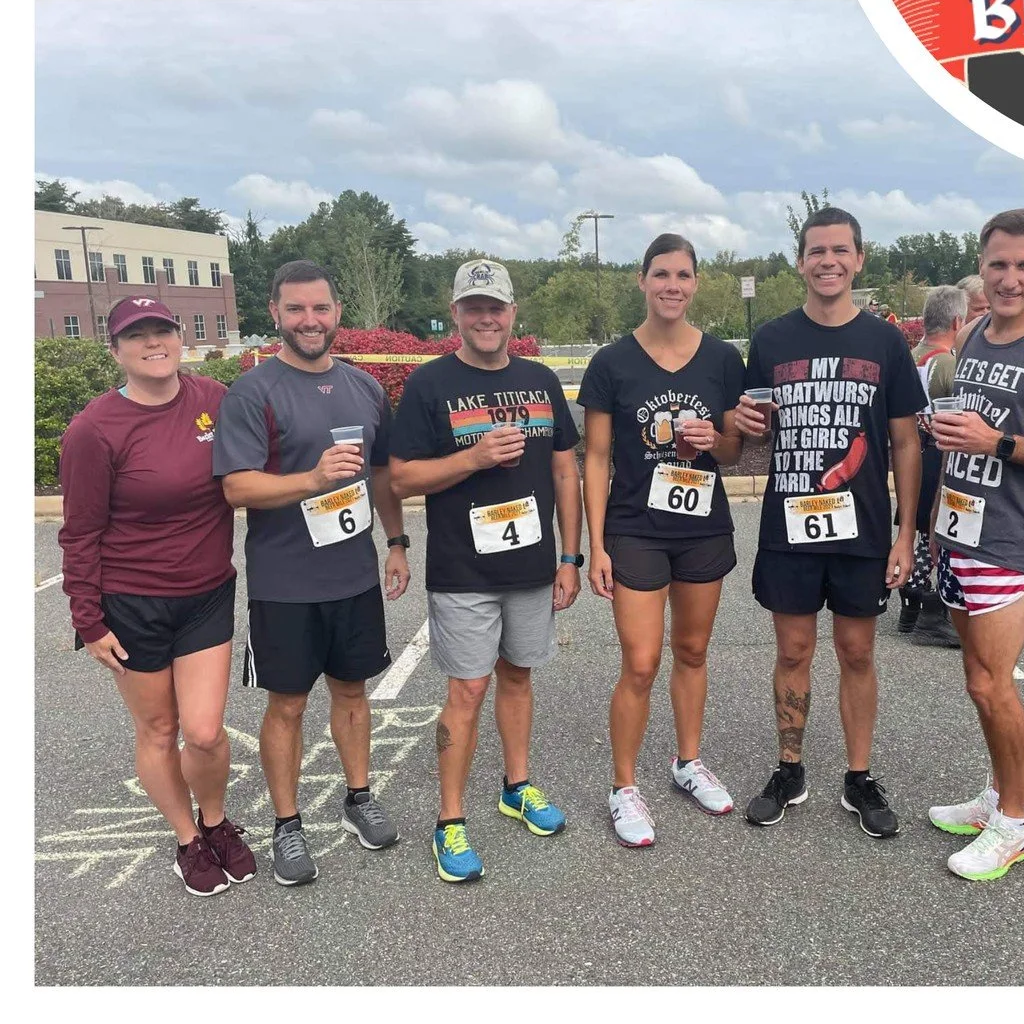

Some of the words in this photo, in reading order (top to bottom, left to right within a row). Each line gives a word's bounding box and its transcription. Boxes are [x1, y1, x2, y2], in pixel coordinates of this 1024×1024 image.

[132, 298, 156, 308] VT
[811, 357, 840, 379] MY
[955, 358, 988, 382] LET'S
[446, 394, 488, 413] LAKE
[494, 390, 551, 406] TITICACA
[773, 381, 877, 407] BRATWURST
[487, 405, 530, 426] 1979
[834, 404, 861, 427] ALL
[801, 427, 849, 450] GIRLS
[774, 451, 791, 472] TO
[793, 450, 825, 471] THE
[945, 451, 1003, 488] ACED
[667, 485, 700, 512] 60
[338, 508, 356, 534] 6
[501, 520, 520, 546] 4
[804, 513, 838, 540] 61
[947, 510, 959, 538] 2
